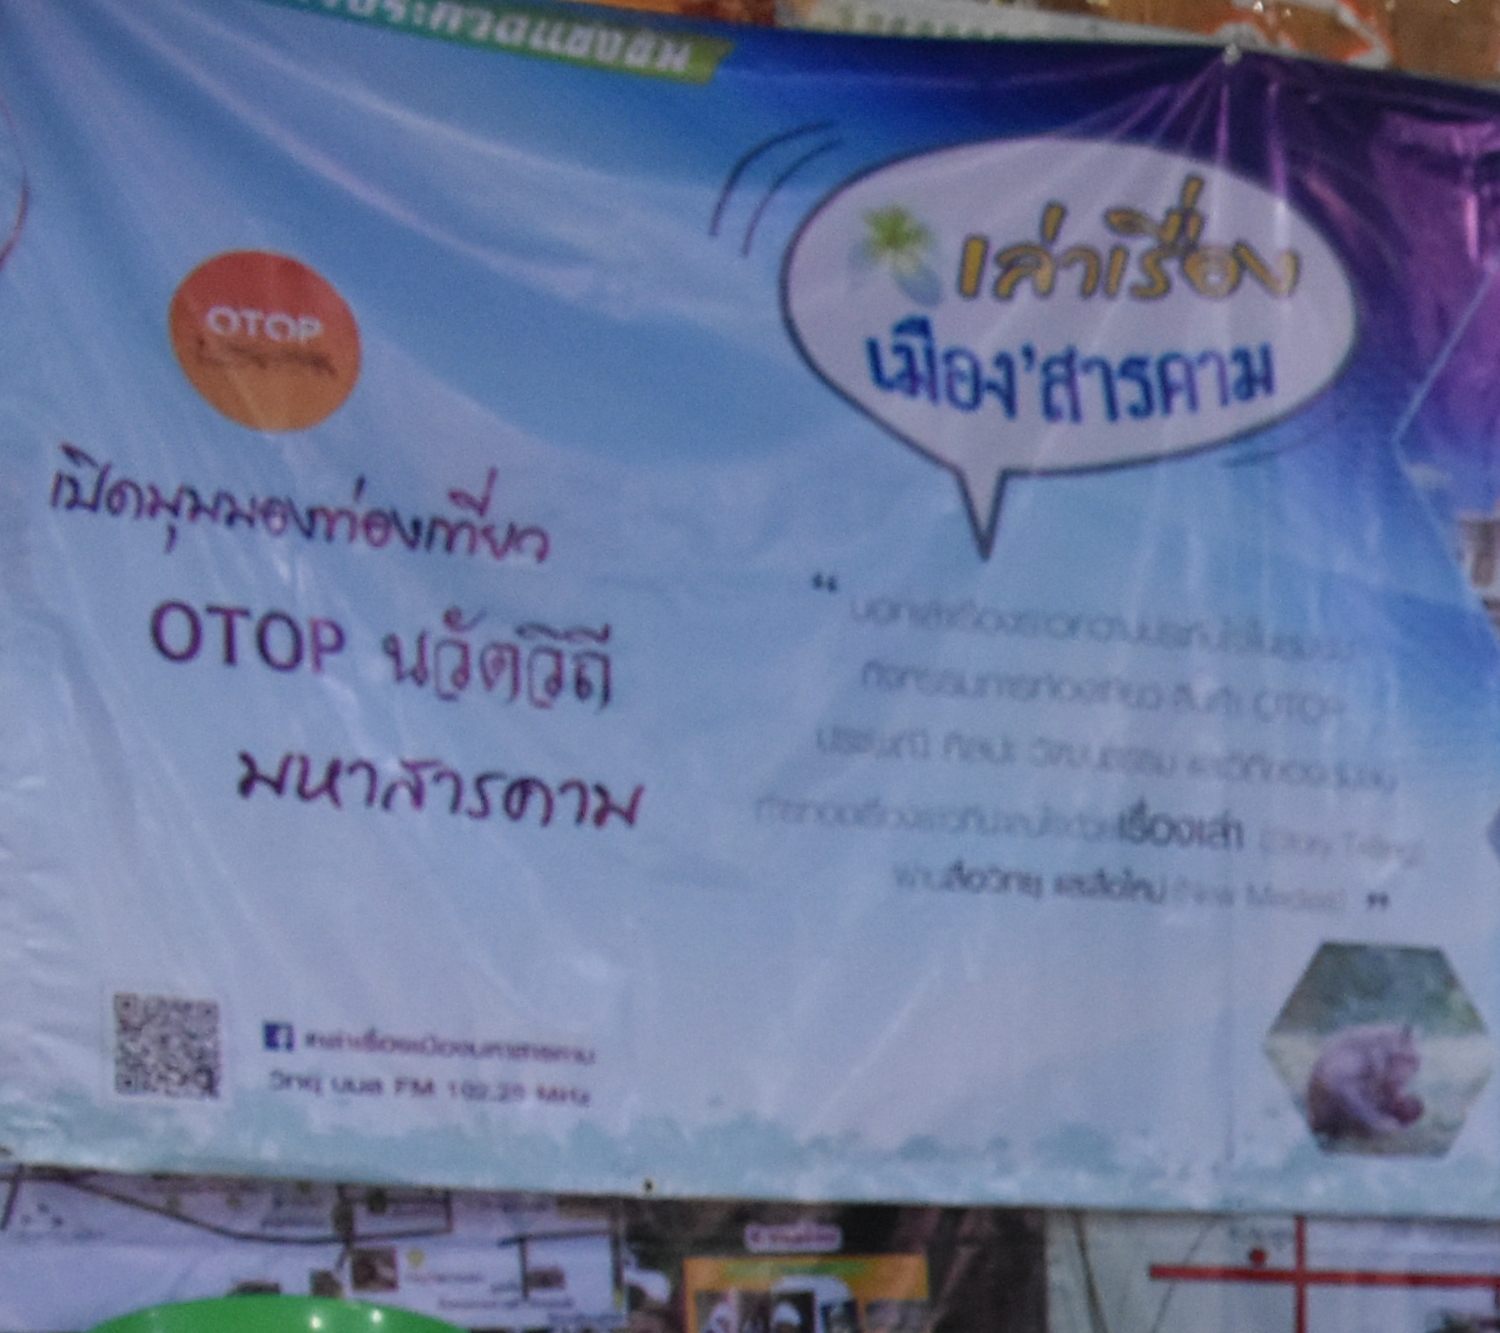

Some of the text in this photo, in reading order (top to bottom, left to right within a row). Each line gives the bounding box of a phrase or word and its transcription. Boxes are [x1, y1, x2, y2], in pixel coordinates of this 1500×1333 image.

[957, 176, 1300, 303] เล่าเรื่อง
[205, 304, 324, 345] OTOP
[150, 600, 346, 674] OTOP
[237, 749, 644, 827] มหาสารคาม
